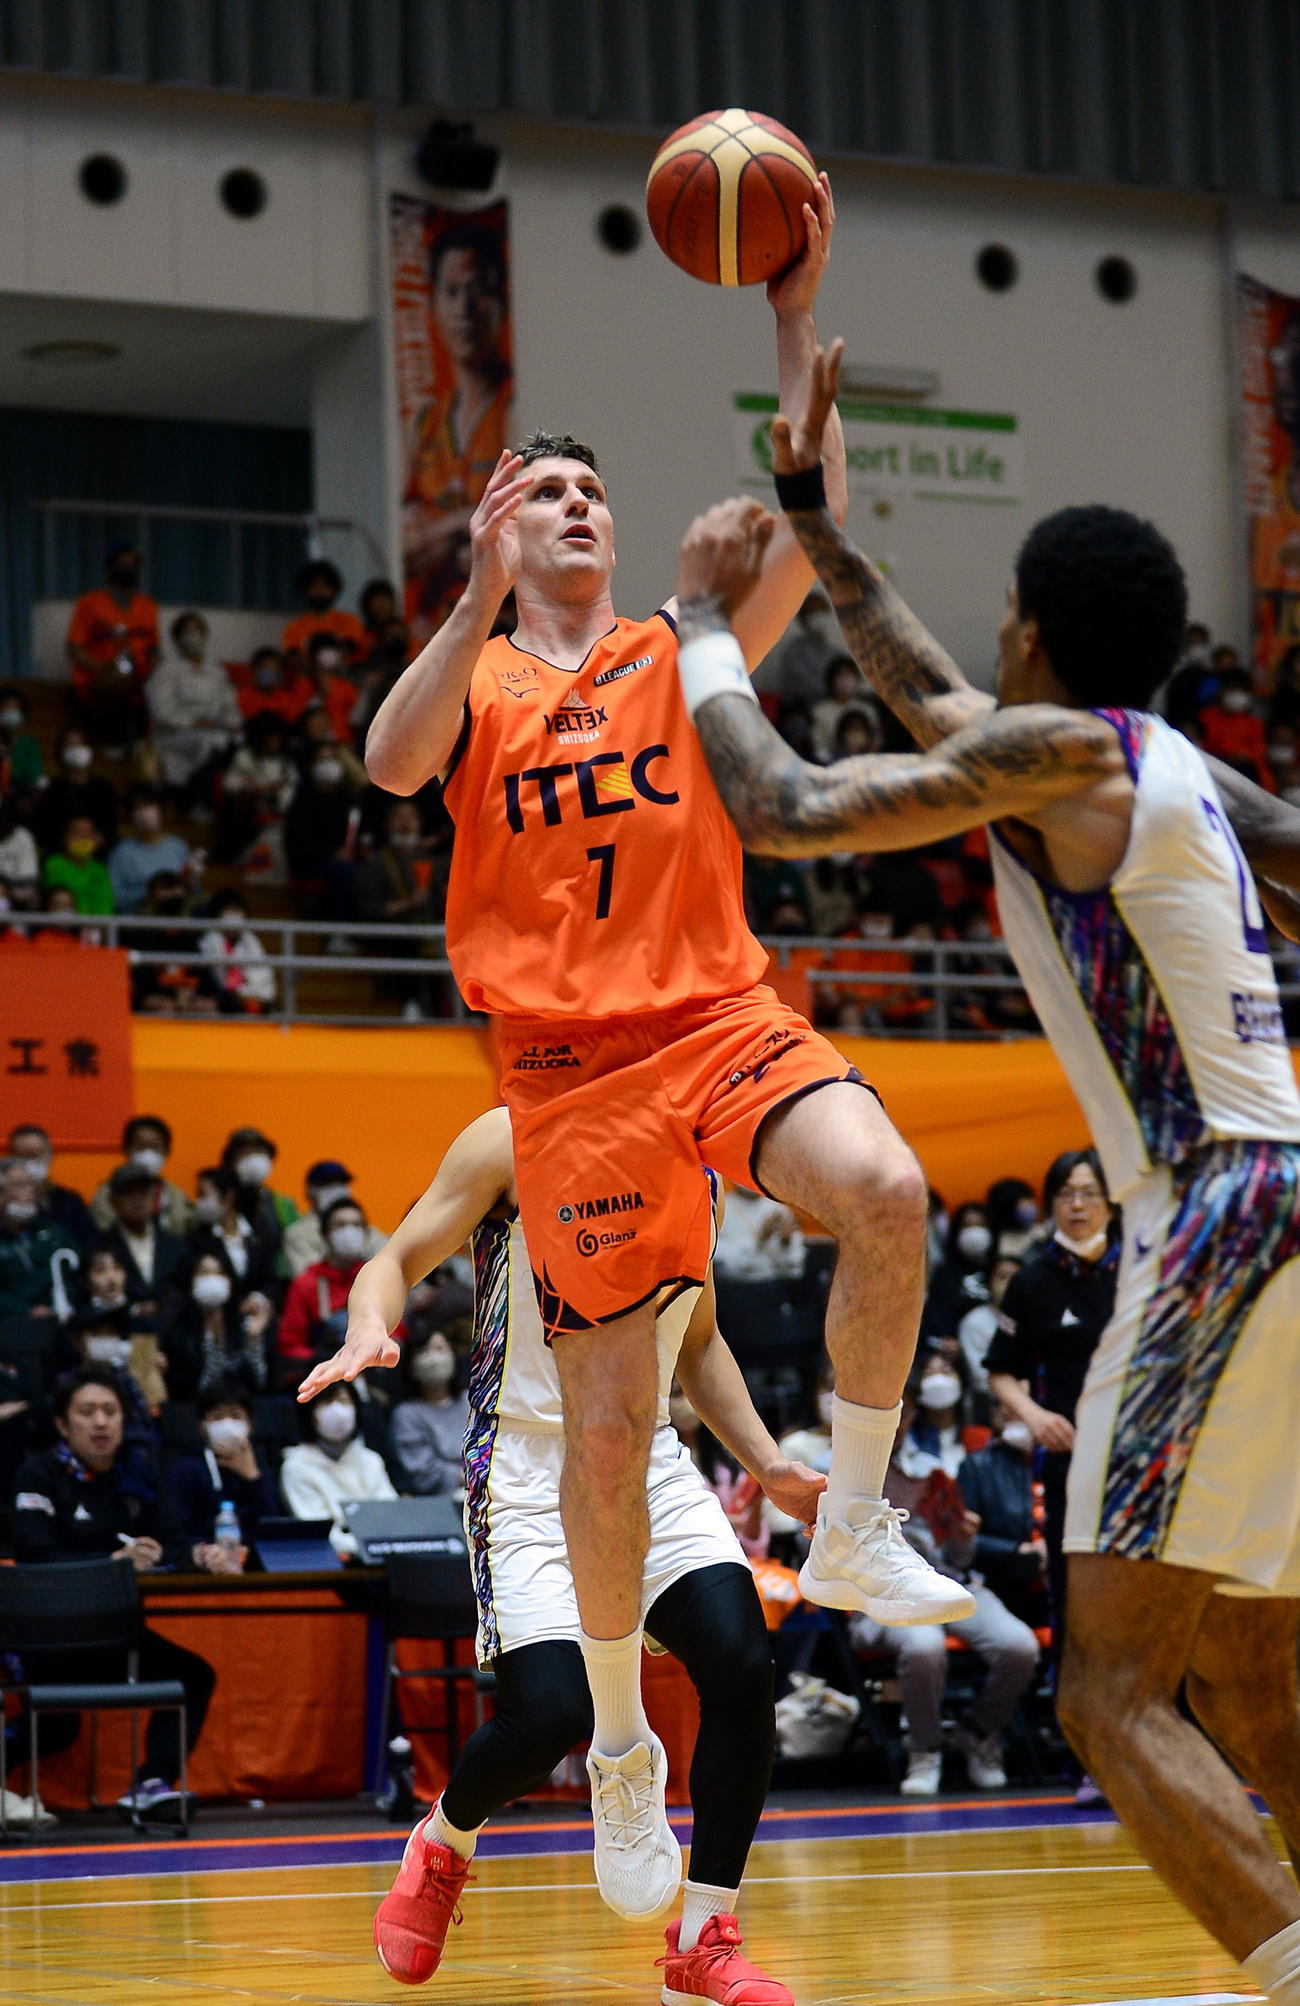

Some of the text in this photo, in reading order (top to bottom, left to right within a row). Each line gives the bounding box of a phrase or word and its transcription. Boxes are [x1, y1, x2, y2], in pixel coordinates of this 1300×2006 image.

[910, 441, 941, 476] in
[558, 730, 600, 745] SHIZUOKA
[503, 744, 680, 835] ITEC
[574, 1191, 645, 1220] YAMAHA
